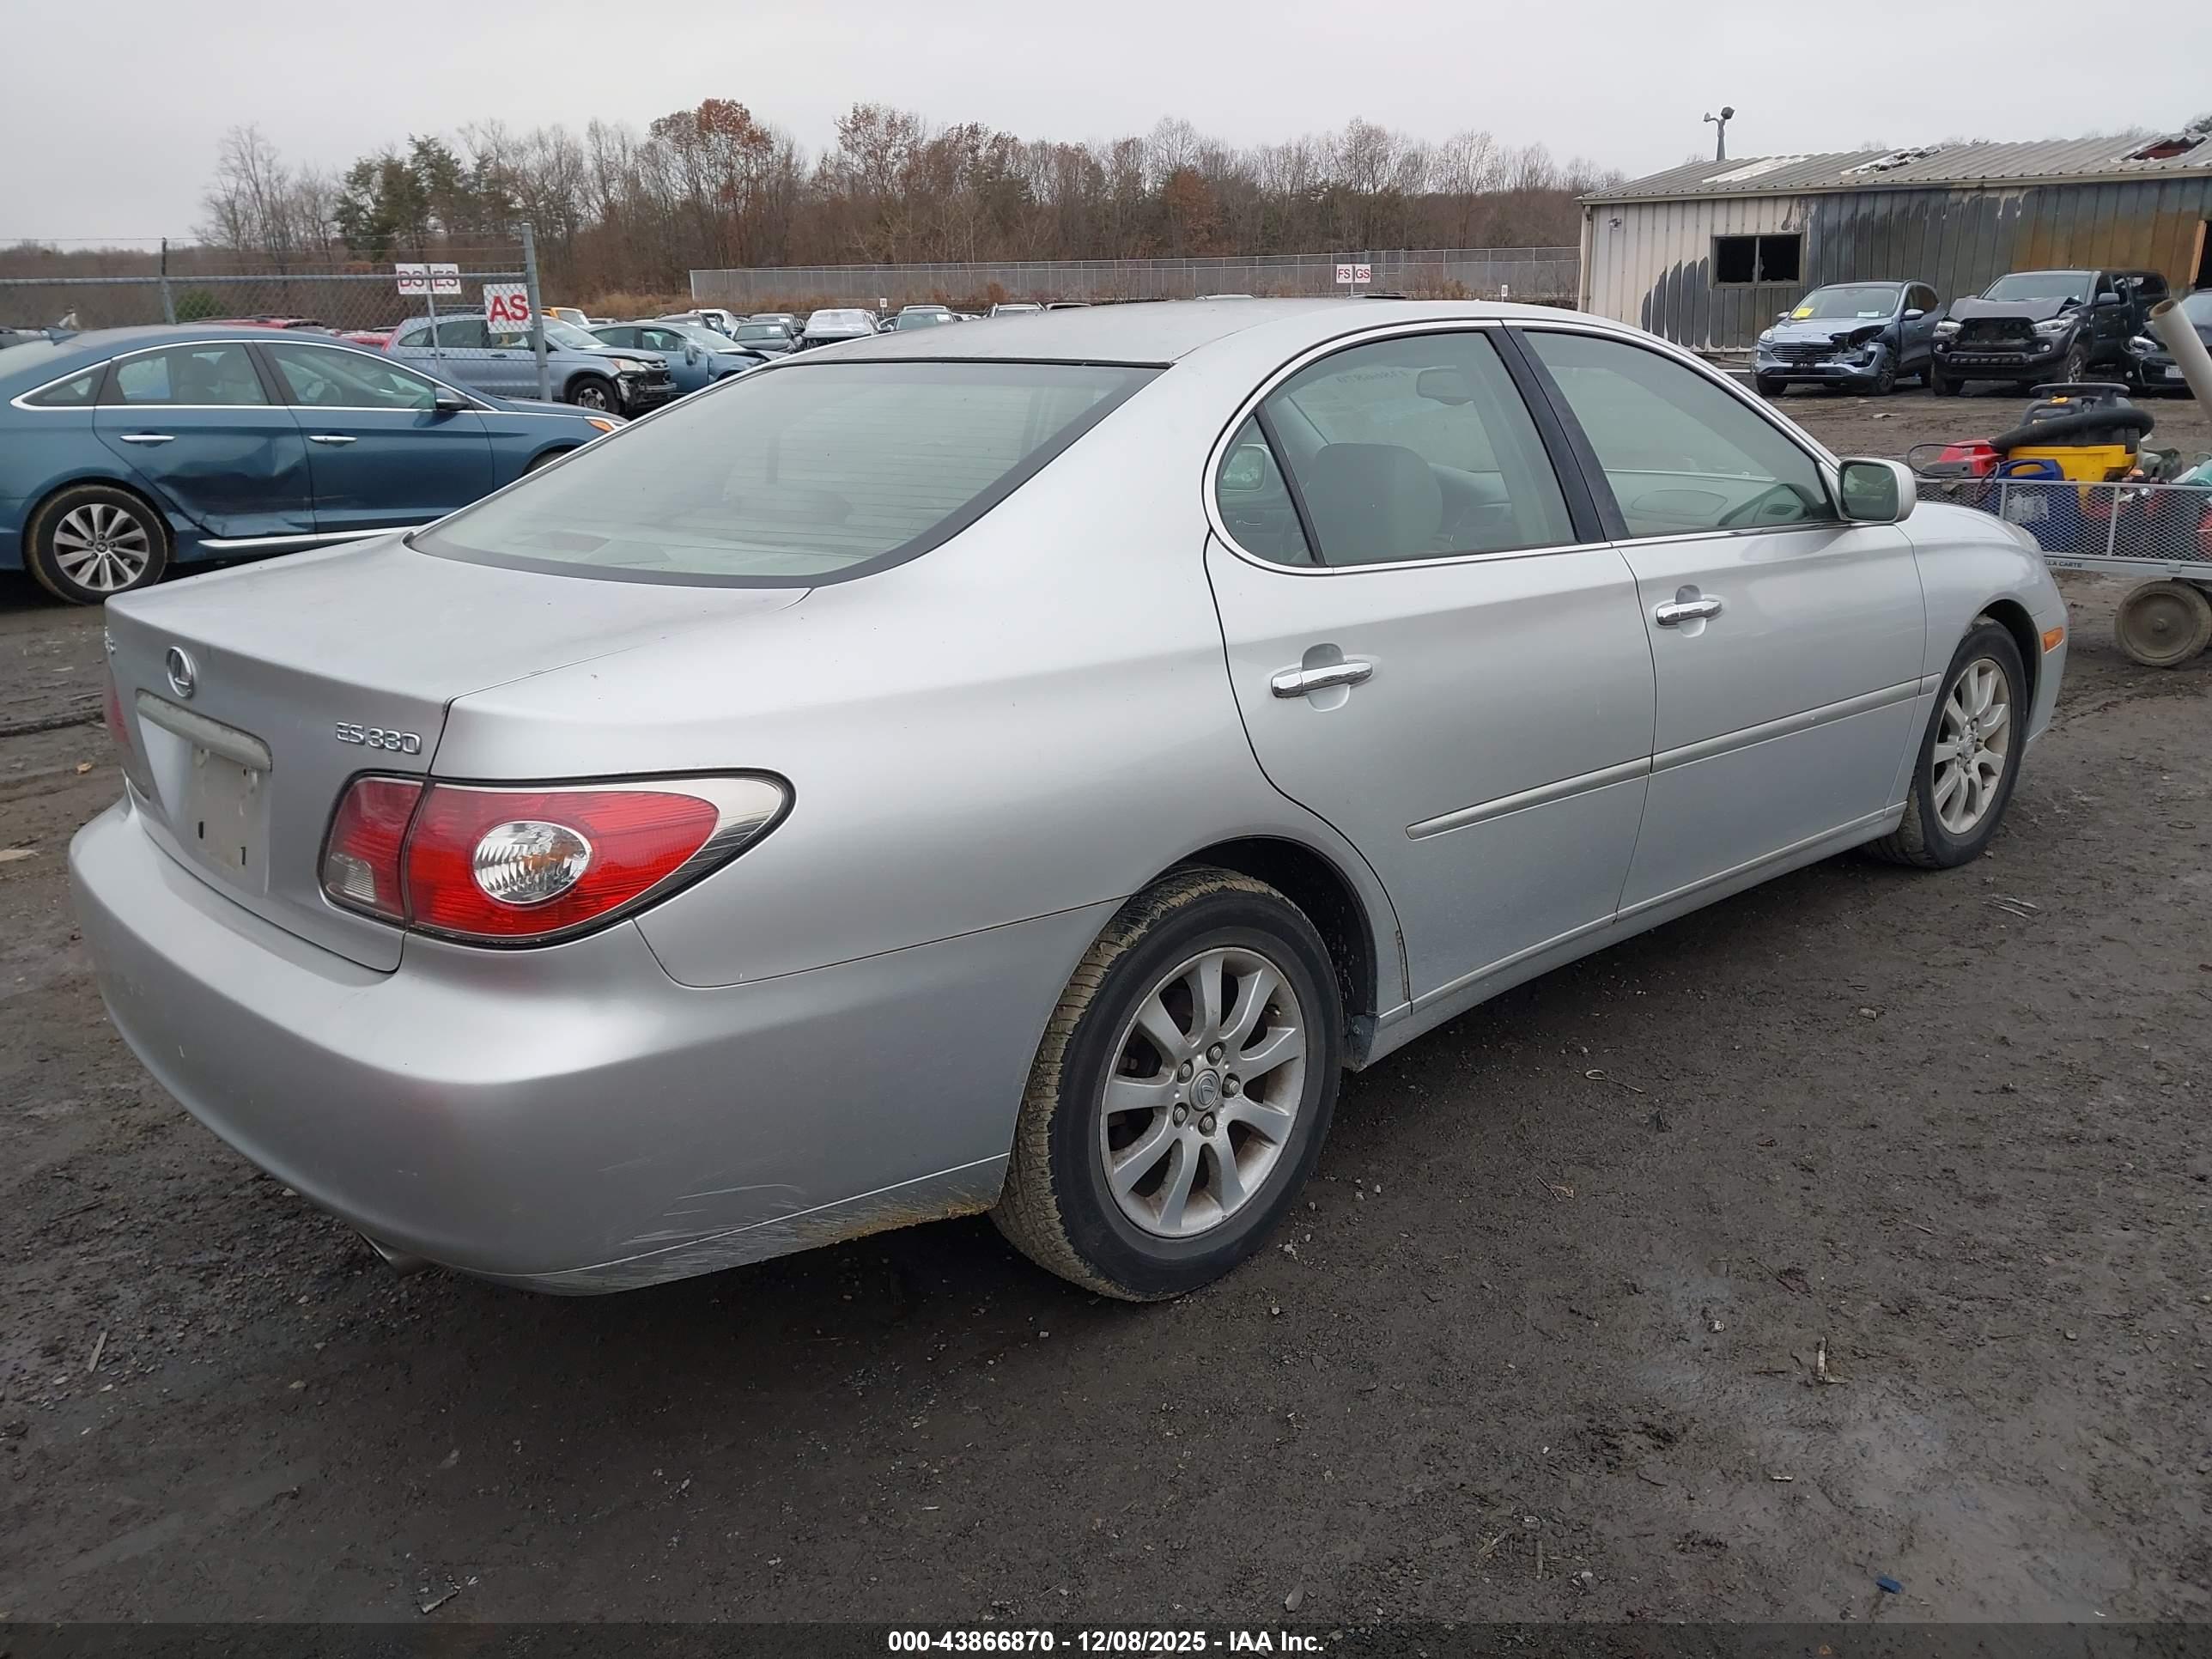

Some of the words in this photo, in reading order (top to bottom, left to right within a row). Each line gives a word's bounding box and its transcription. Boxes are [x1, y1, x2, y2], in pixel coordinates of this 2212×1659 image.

[398, 270, 424, 287] DS
[433, 270, 458, 286] ES
[1338, 268, 1351, 279] FS
[1356, 268, 1370, 279] GS
[489, 295, 529, 322] AS
